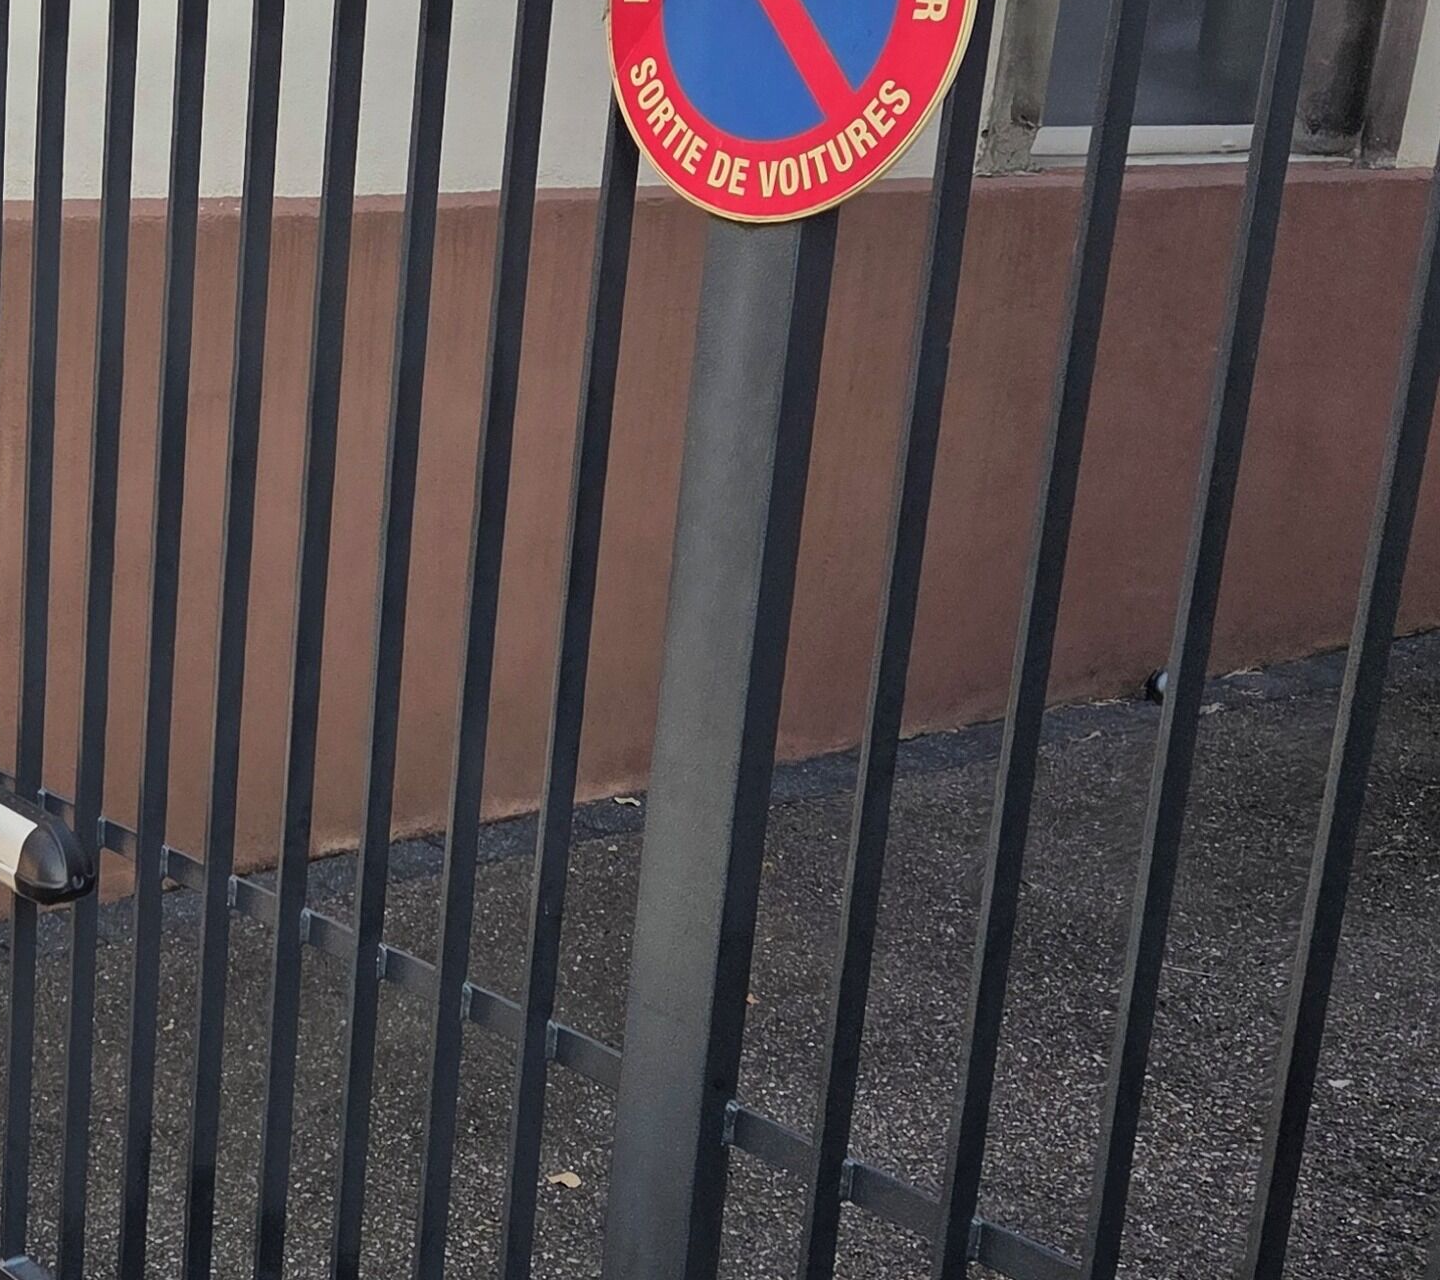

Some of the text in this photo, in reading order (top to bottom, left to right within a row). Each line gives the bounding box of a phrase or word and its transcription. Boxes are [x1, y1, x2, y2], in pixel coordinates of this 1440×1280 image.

[630, 55, 912, 199] SORTIE DE VOITURES
